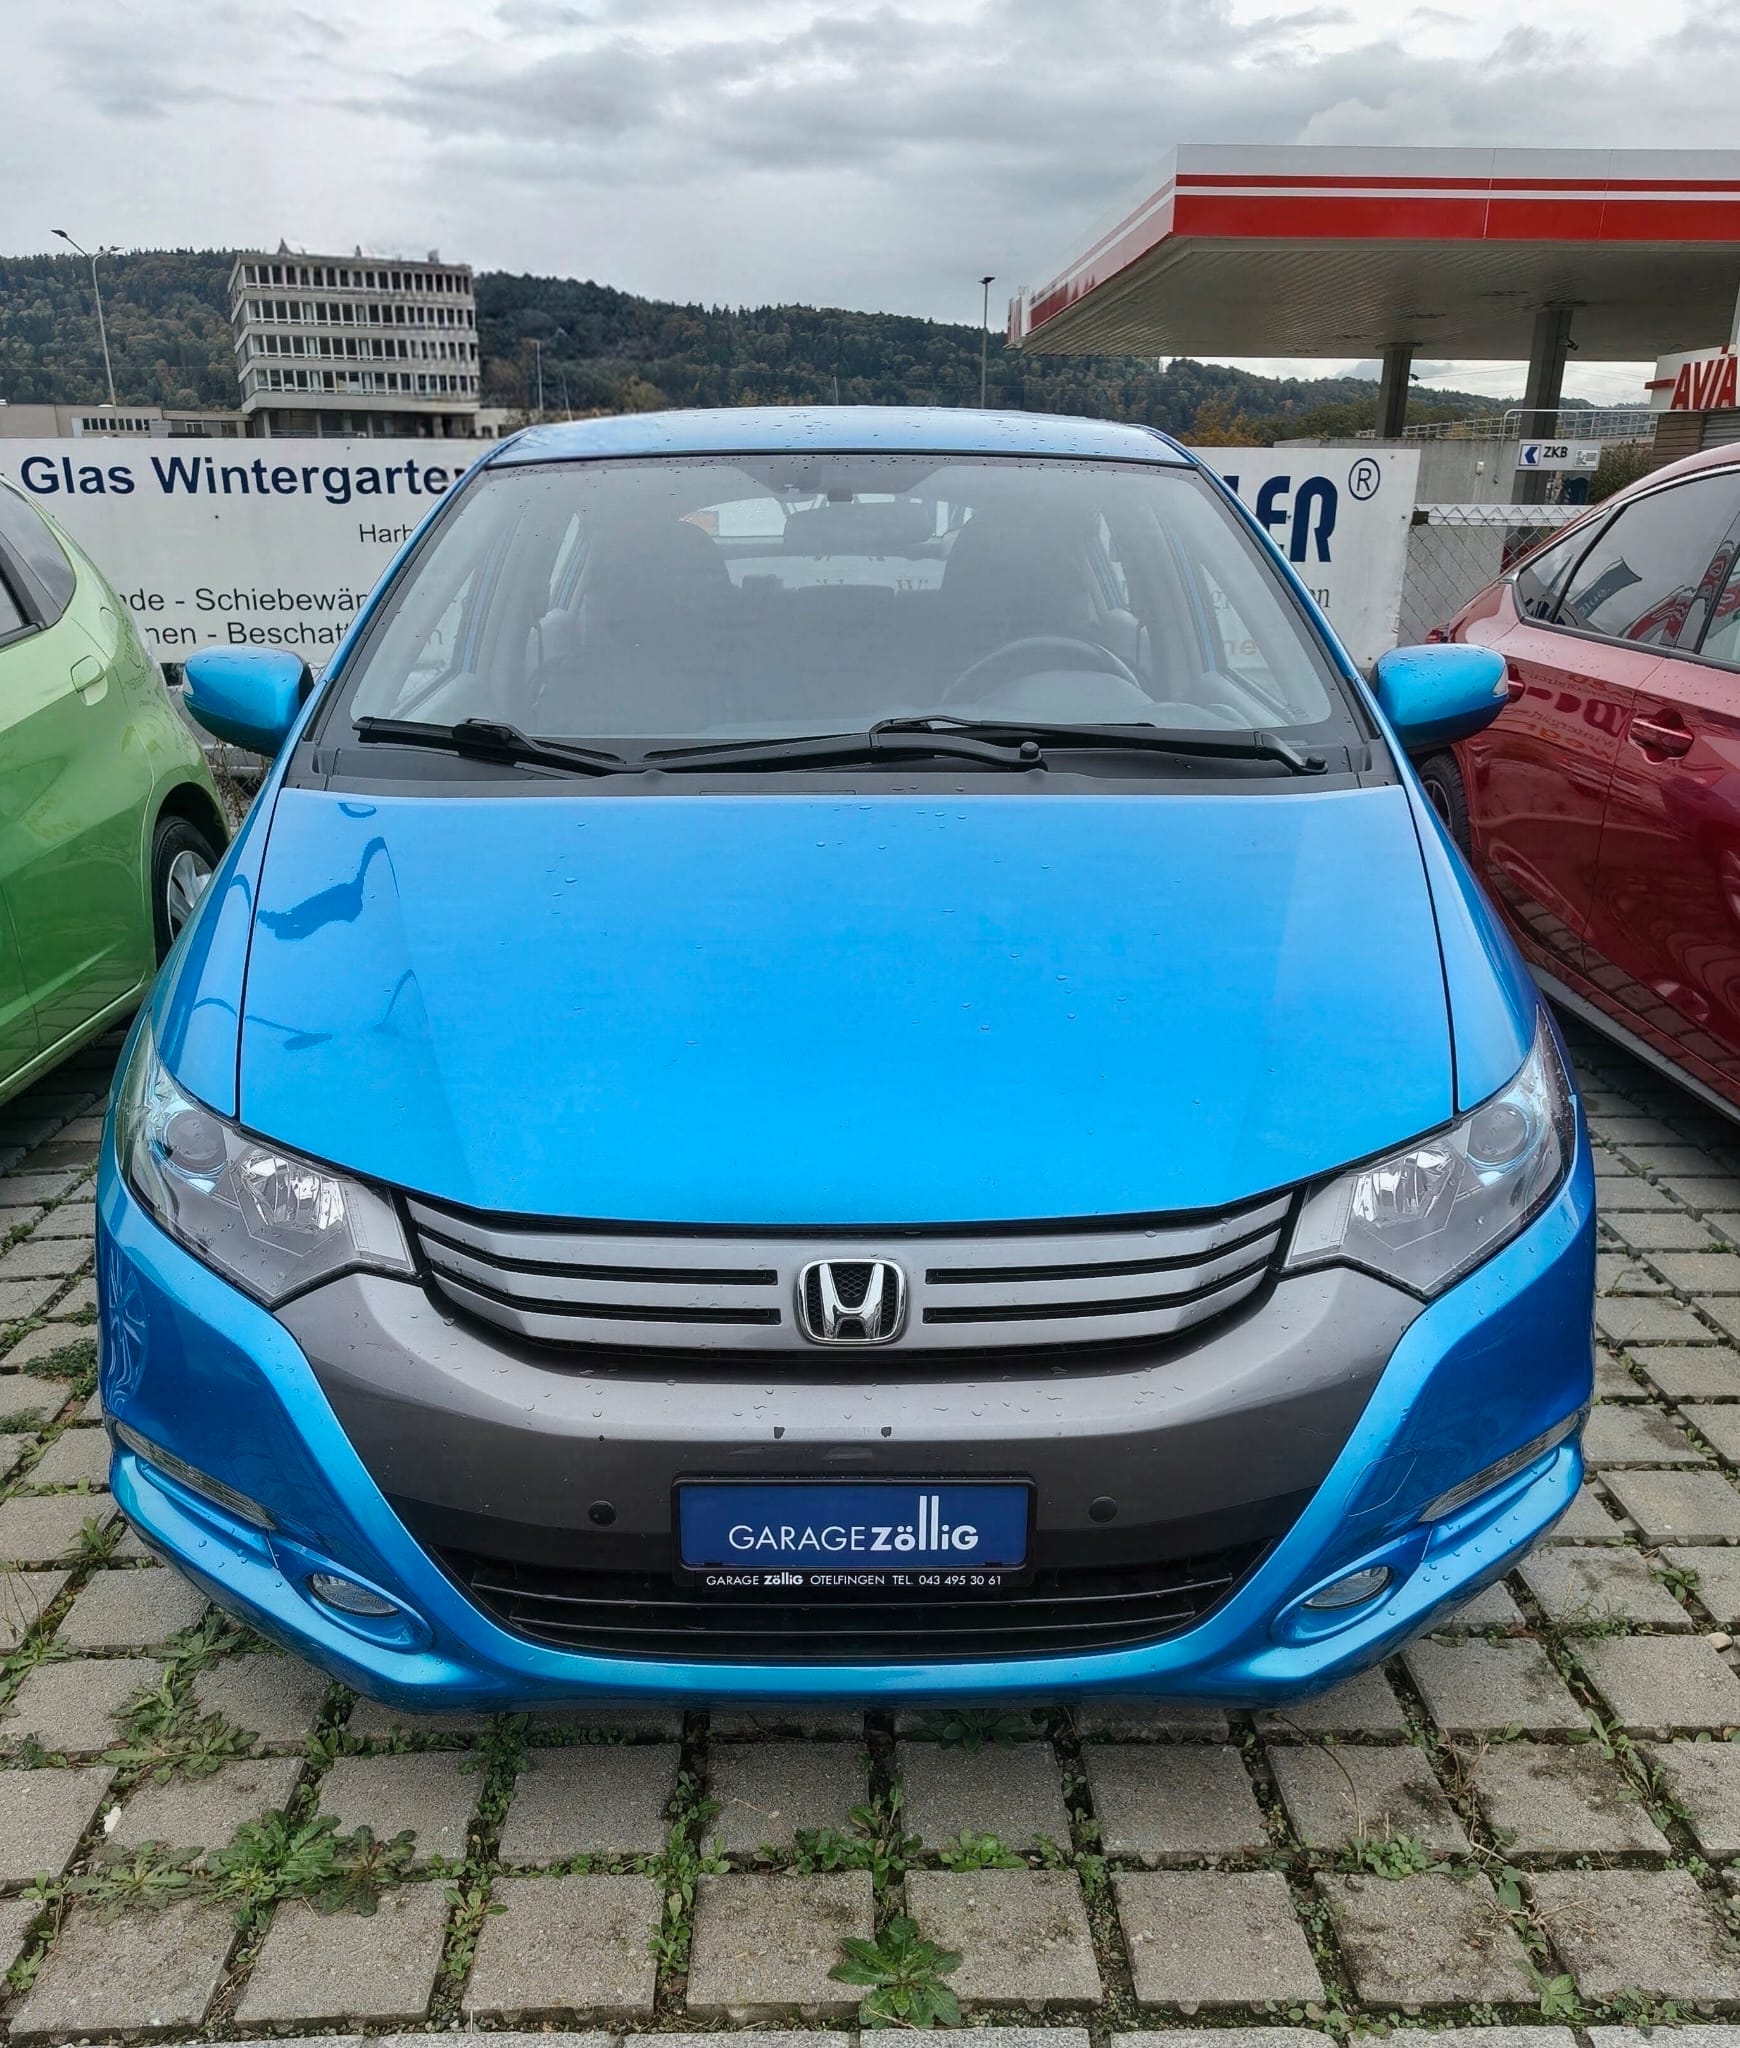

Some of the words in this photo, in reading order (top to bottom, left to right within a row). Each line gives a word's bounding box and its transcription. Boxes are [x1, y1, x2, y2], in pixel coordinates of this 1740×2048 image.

[1669, 356, 1738, 410] AVIA
[1543, 446, 1568, 458] ZKB
[20, 456, 135, 495] Glas
[151, 456, 468, 504] Wintergarte
[119, 587, 165, 611] de
[706, 1575, 760, 1586] GARAGE
[810, 1575, 885, 1586] OTELFINGEN
[918, 1575, 941, 1586] 043
[943, 1575, 966, 1586] 495
[969, 1575, 985, 1586] 30
[988, 1575, 1002, 1586] 61
